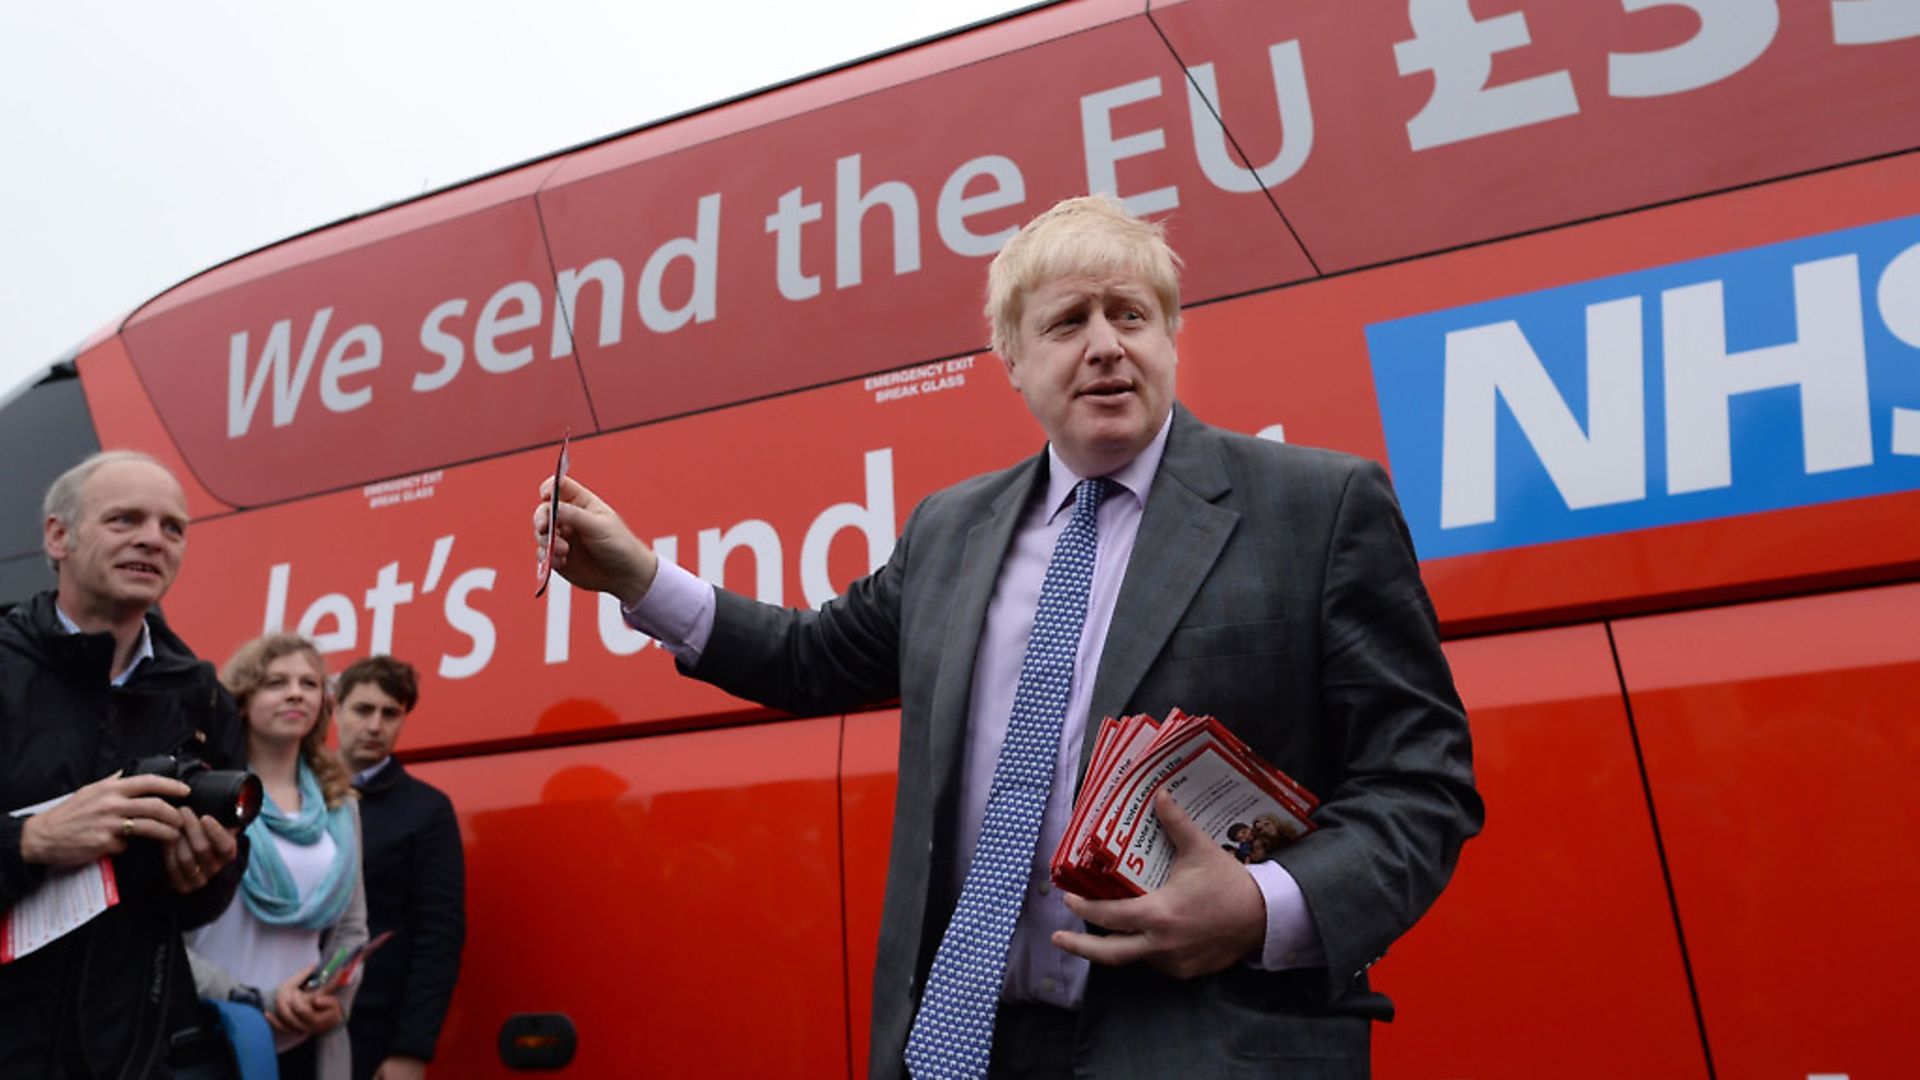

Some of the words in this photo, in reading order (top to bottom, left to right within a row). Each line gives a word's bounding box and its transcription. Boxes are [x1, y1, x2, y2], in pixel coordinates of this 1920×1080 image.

[226, 307, 383, 439] We
[412, 192, 722, 392] send
[765, 153, 1026, 301] the
[1080, 39, 1315, 217] EU
[864, 364, 944, 390] EMERGENCY
[946, 356, 975, 373] EXIT
[1440, 237, 1920, 530] NH
[876, 384, 920, 403] BREAK
[921, 374, 966, 392] GLASS
[1124, 805, 1139, 826] Vote
[1134, 825, 1149, 848] Vote
[1126, 852, 1144, 876] 5
